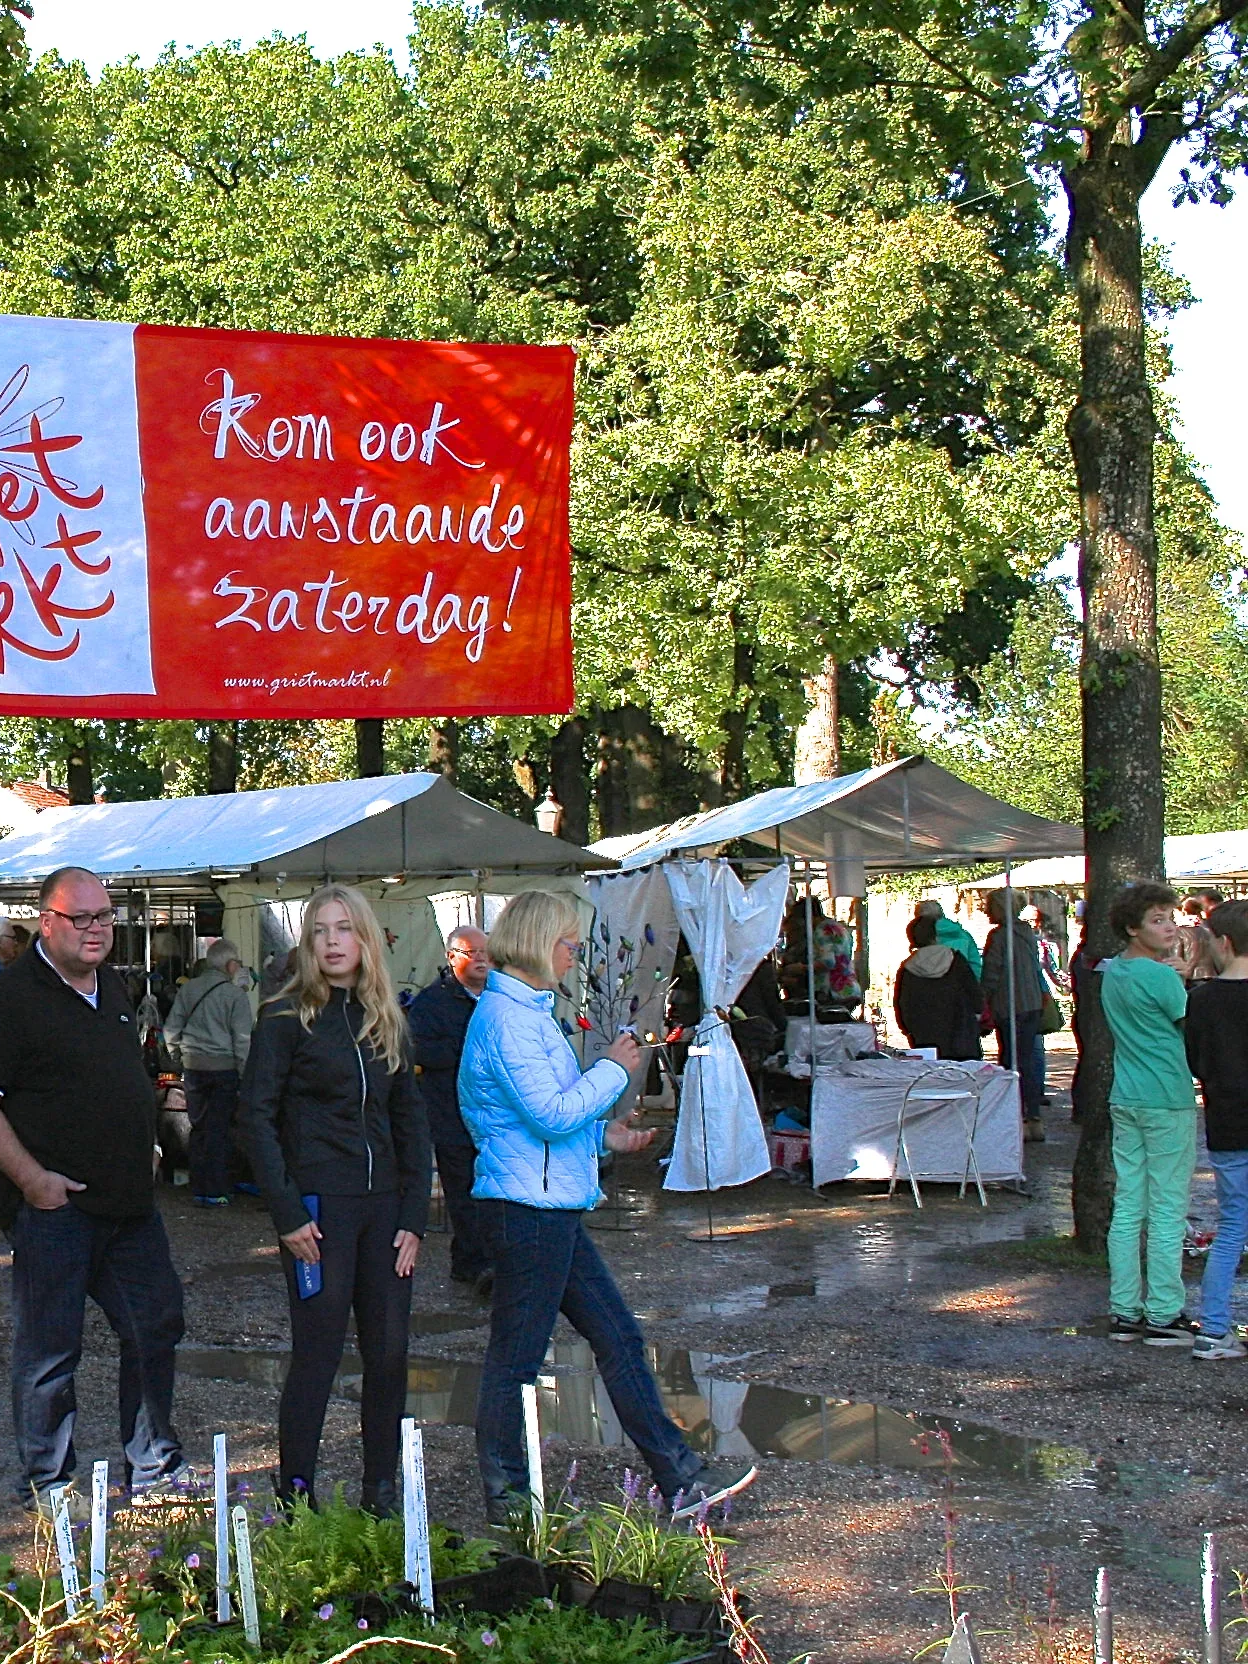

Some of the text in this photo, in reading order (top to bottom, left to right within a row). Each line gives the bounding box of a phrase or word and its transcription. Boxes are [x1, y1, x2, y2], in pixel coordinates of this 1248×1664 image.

[199, 368, 486, 469] Kom ook
[205, 483, 525, 553] aanstaande
[213, 566, 522, 663] zaterdag!
[223, 668, 392, 696] www.grietmarkt.nl
